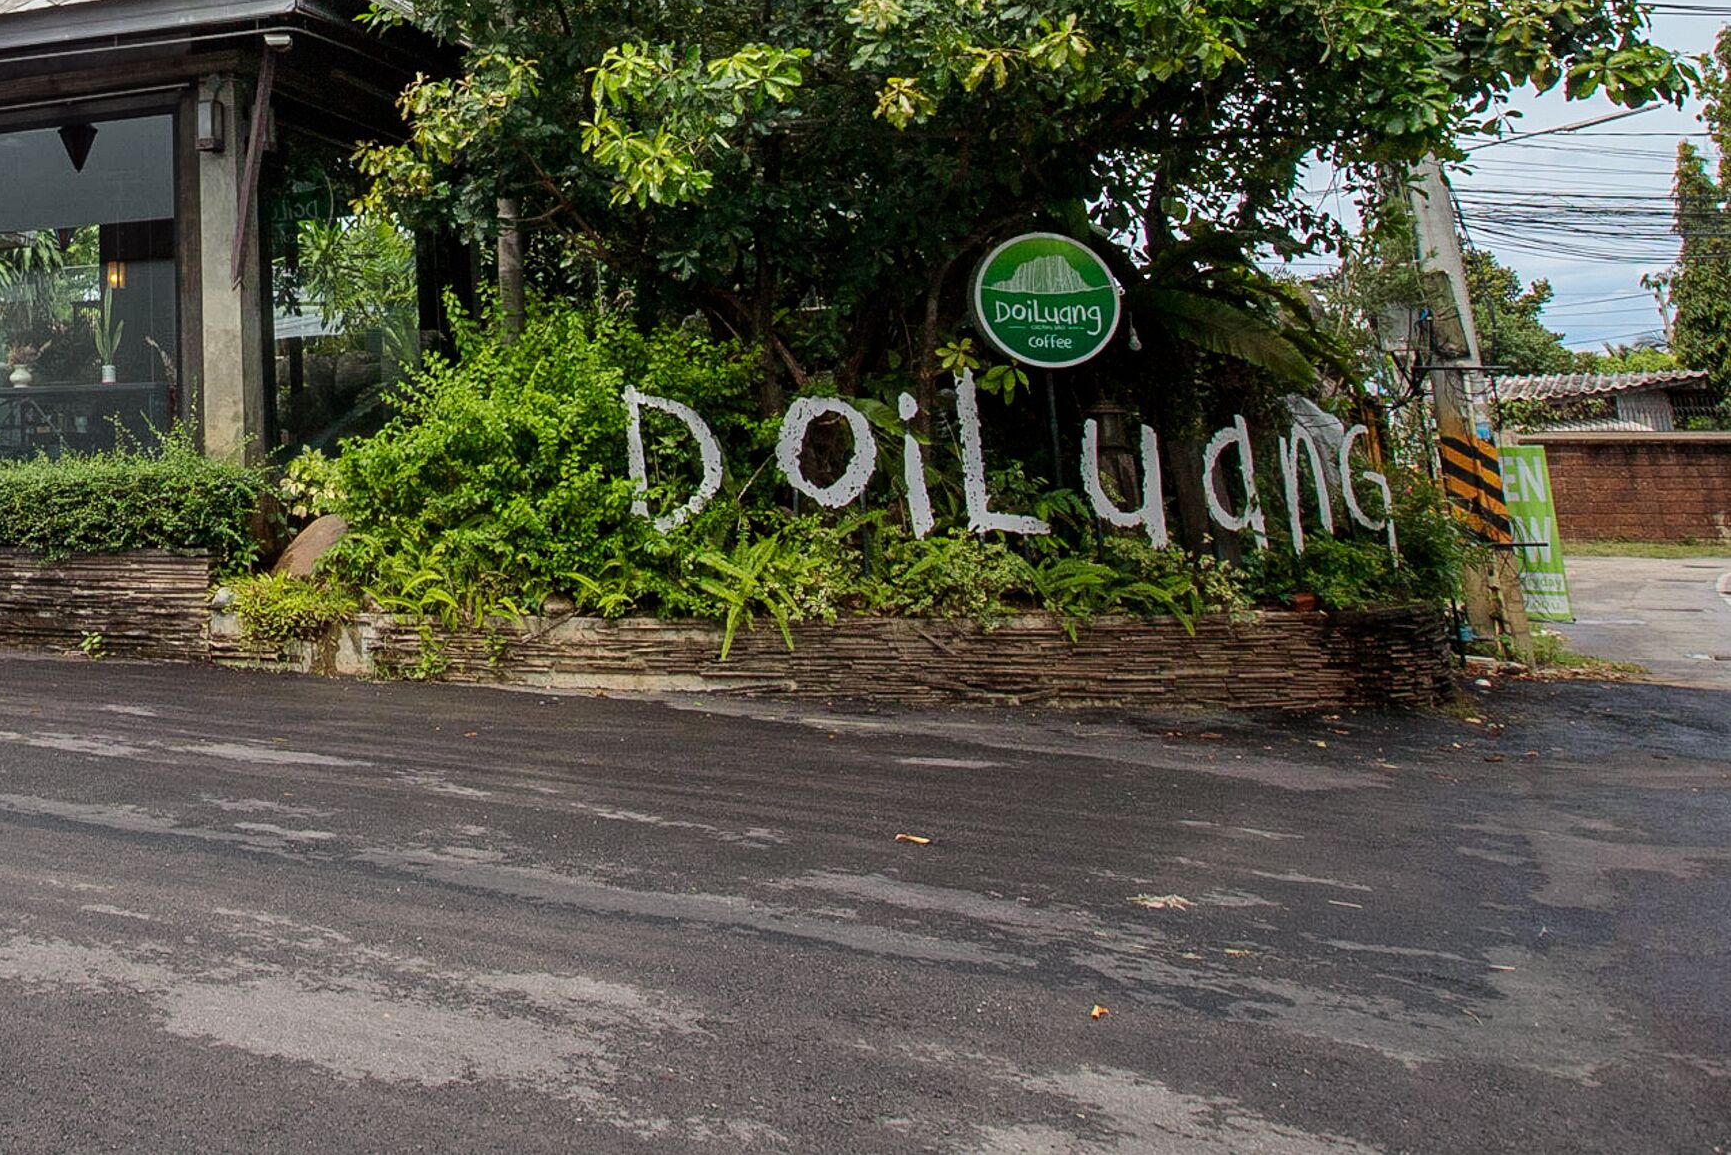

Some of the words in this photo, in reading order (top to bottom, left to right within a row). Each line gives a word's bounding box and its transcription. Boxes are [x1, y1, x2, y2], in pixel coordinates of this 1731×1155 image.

[994, 299, 1102, 336] DoiLuang
[1028, 334, 1072, 349] coffee
[1498, 456, 1547, 502] EN
